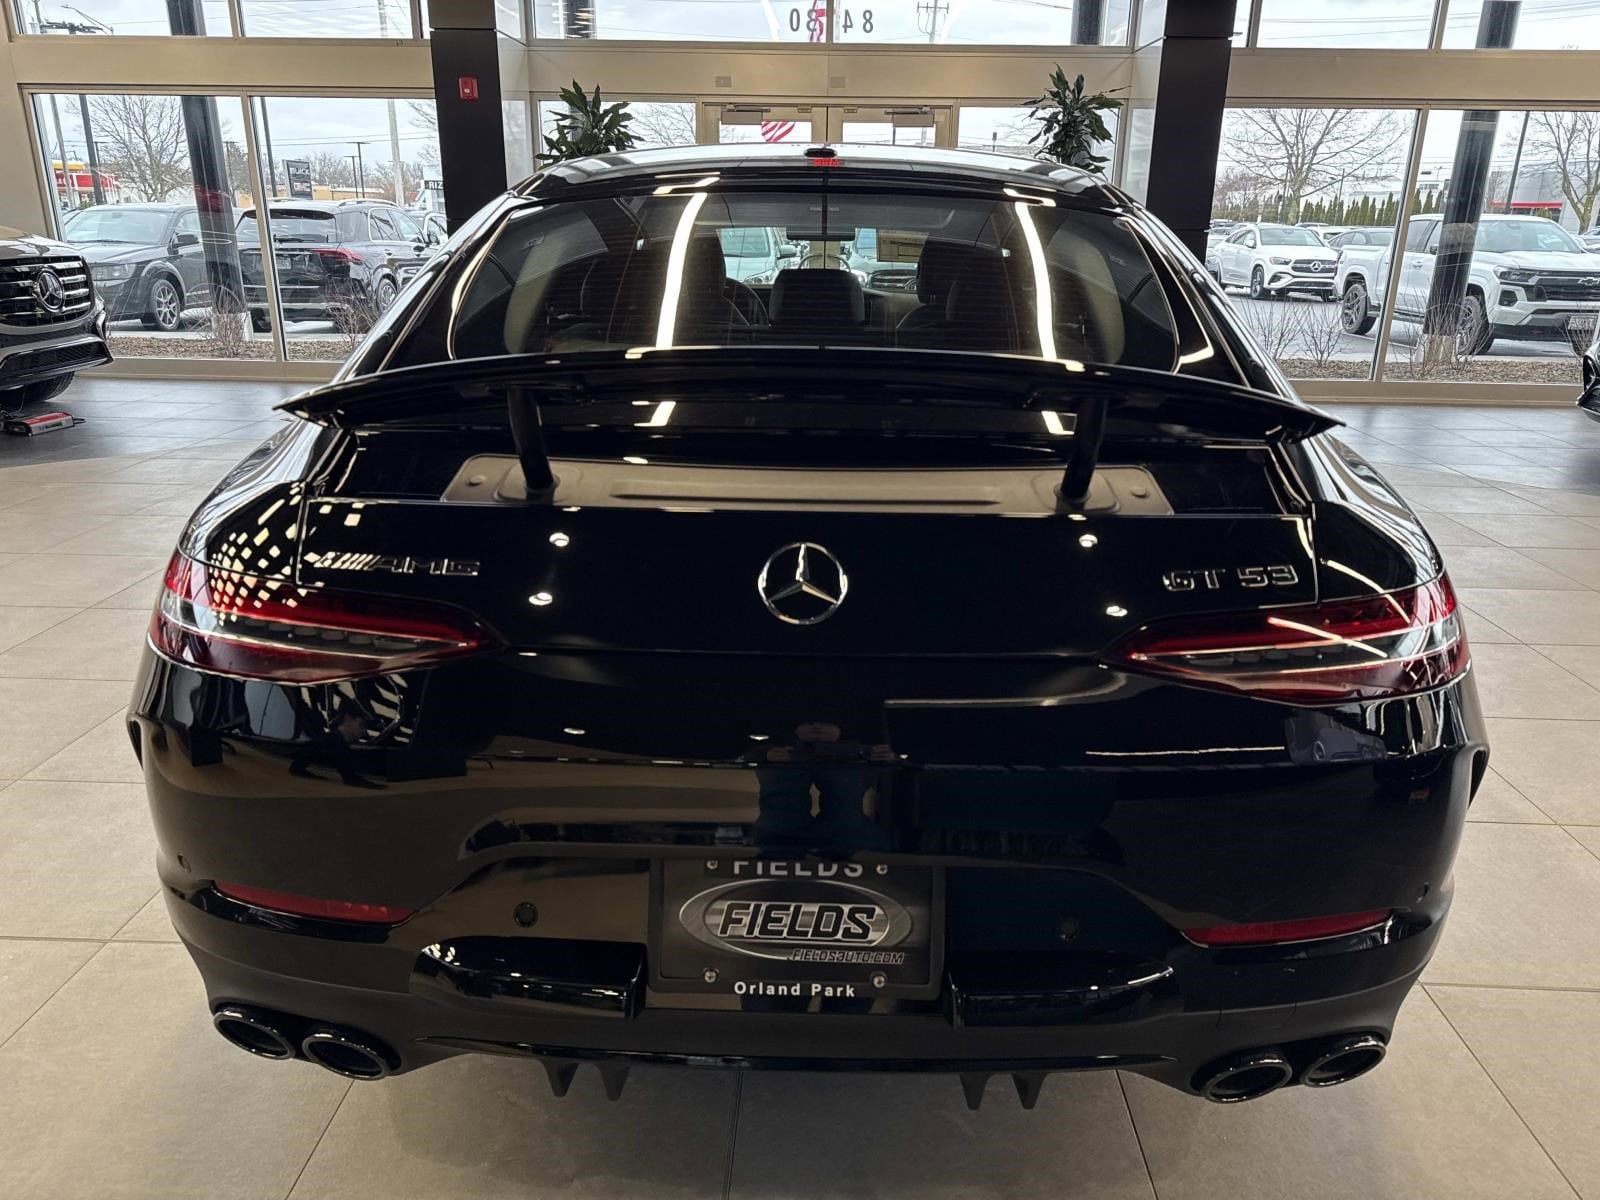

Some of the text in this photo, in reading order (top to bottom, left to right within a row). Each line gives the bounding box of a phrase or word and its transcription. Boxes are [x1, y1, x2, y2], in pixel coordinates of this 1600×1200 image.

[1162, 565, 1299, 592] GT 53
[717, 901, 877, 942] FIELDS
[734, 981, 855, 998] Orland Park
